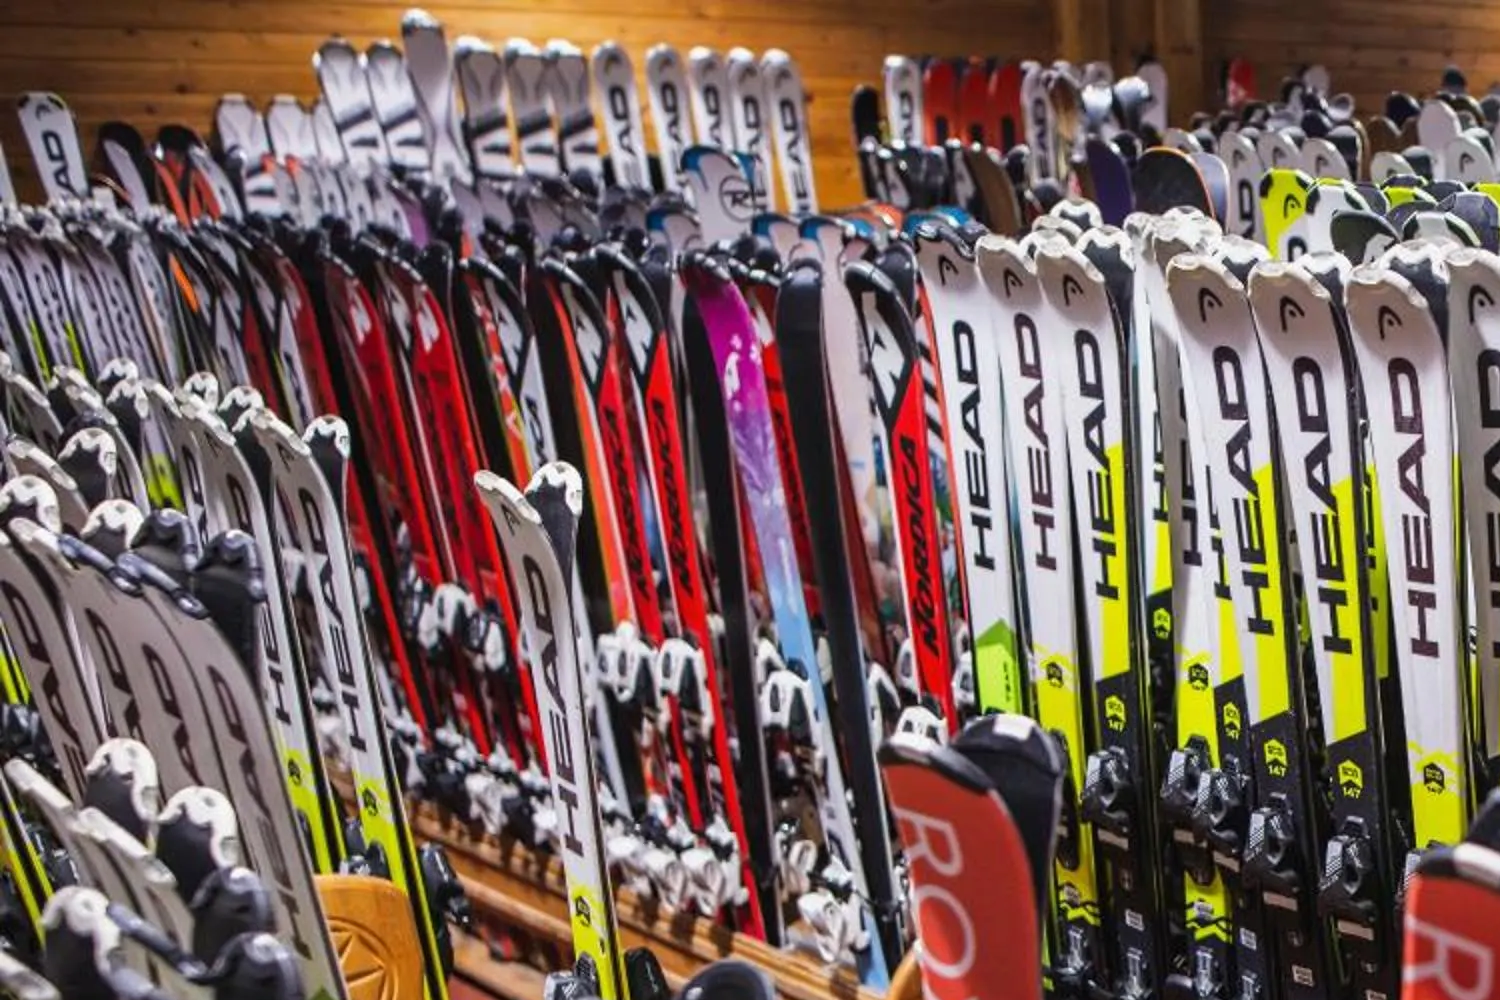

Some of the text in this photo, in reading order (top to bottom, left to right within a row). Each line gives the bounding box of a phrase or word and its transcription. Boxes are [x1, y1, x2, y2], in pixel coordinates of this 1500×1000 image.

[900, 435, 940, 658] NORDICA
[952, 320, 996, 571] HEAD
[1013, 312, 1057, 571] HEAD
[1074, 329, 1119, 601] HEAD
[1212, 345, 1275, 636] HEAD
[1291, 356, 1352, 655] HEAD
[1387, 356, 1440, 659] HEAD
[299, 487, 367, 753] HEAD
[523, 553, 585, 858] HEAD
